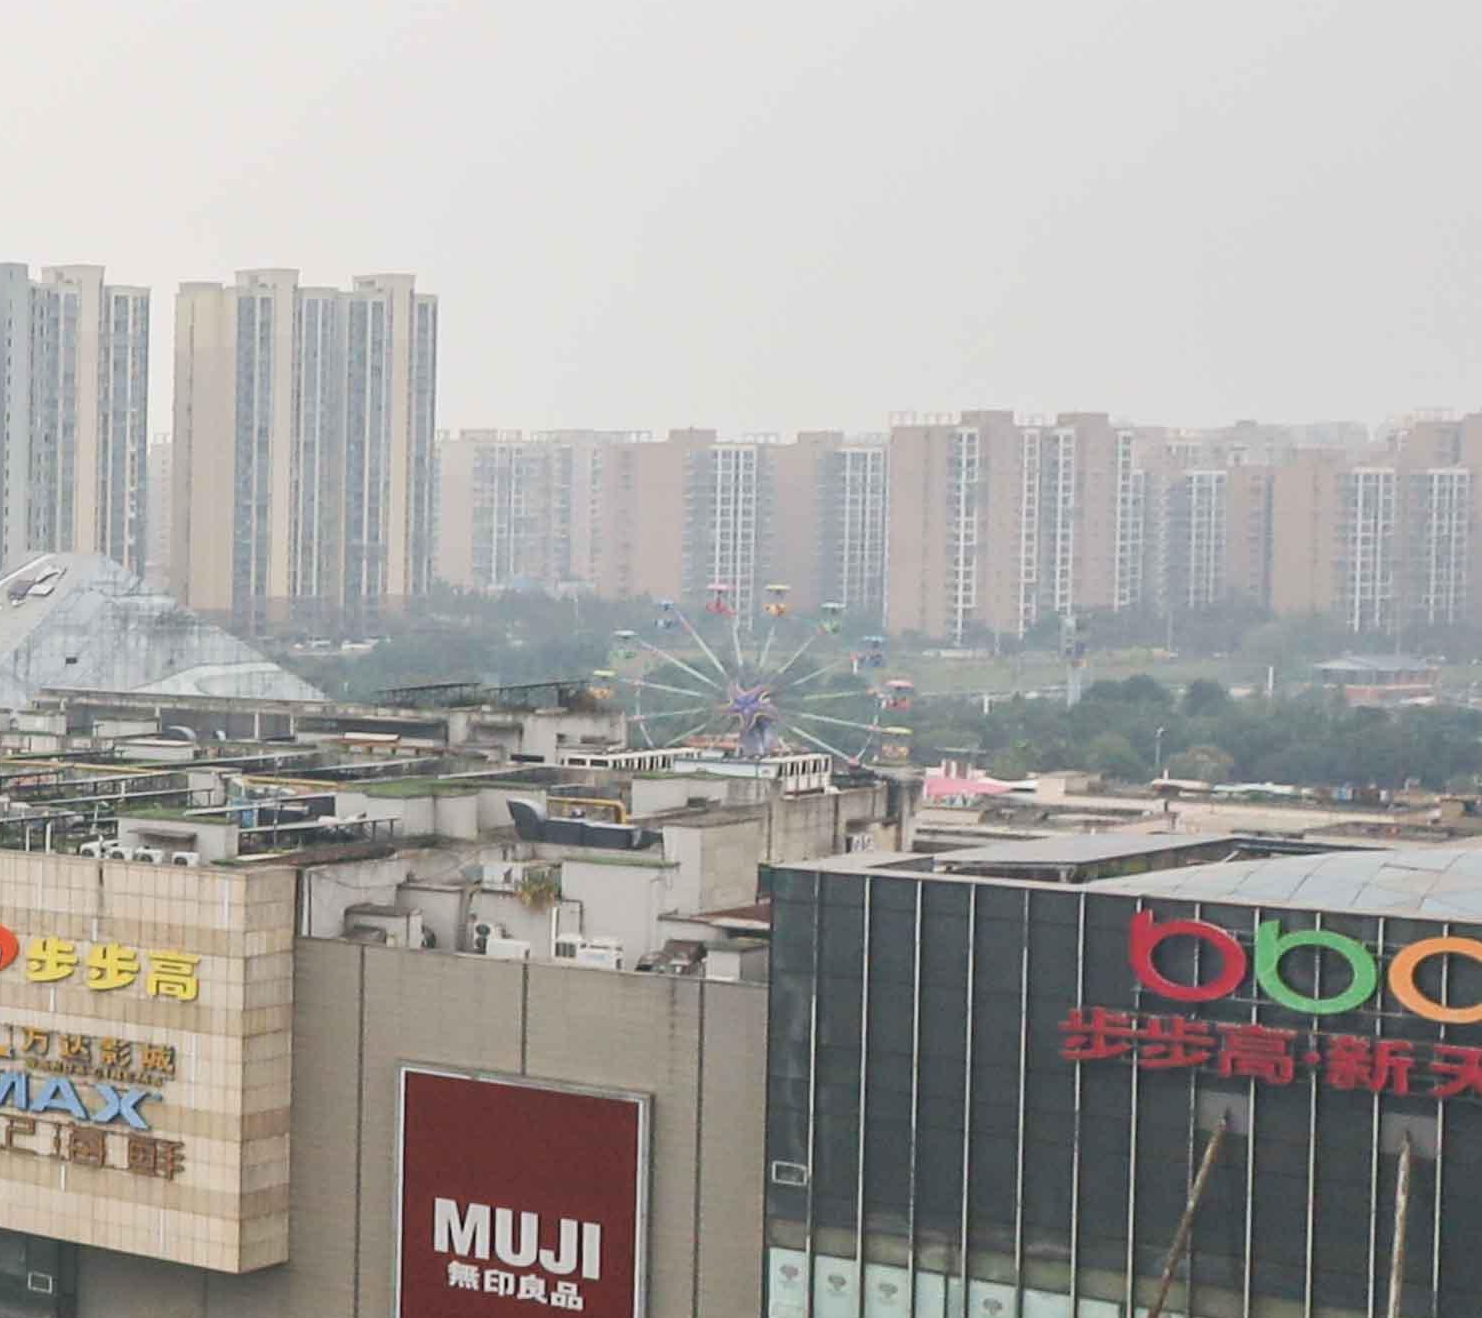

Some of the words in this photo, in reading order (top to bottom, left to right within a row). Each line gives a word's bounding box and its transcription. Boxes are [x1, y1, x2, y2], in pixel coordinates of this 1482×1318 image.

[25, 936, 203, 1002] 步步高
[21, 1027, 177, 1074] 万达影城
[433, 1196, 602, 1281] MUJI
[448, 1259, 584, 1312] 無印良品
